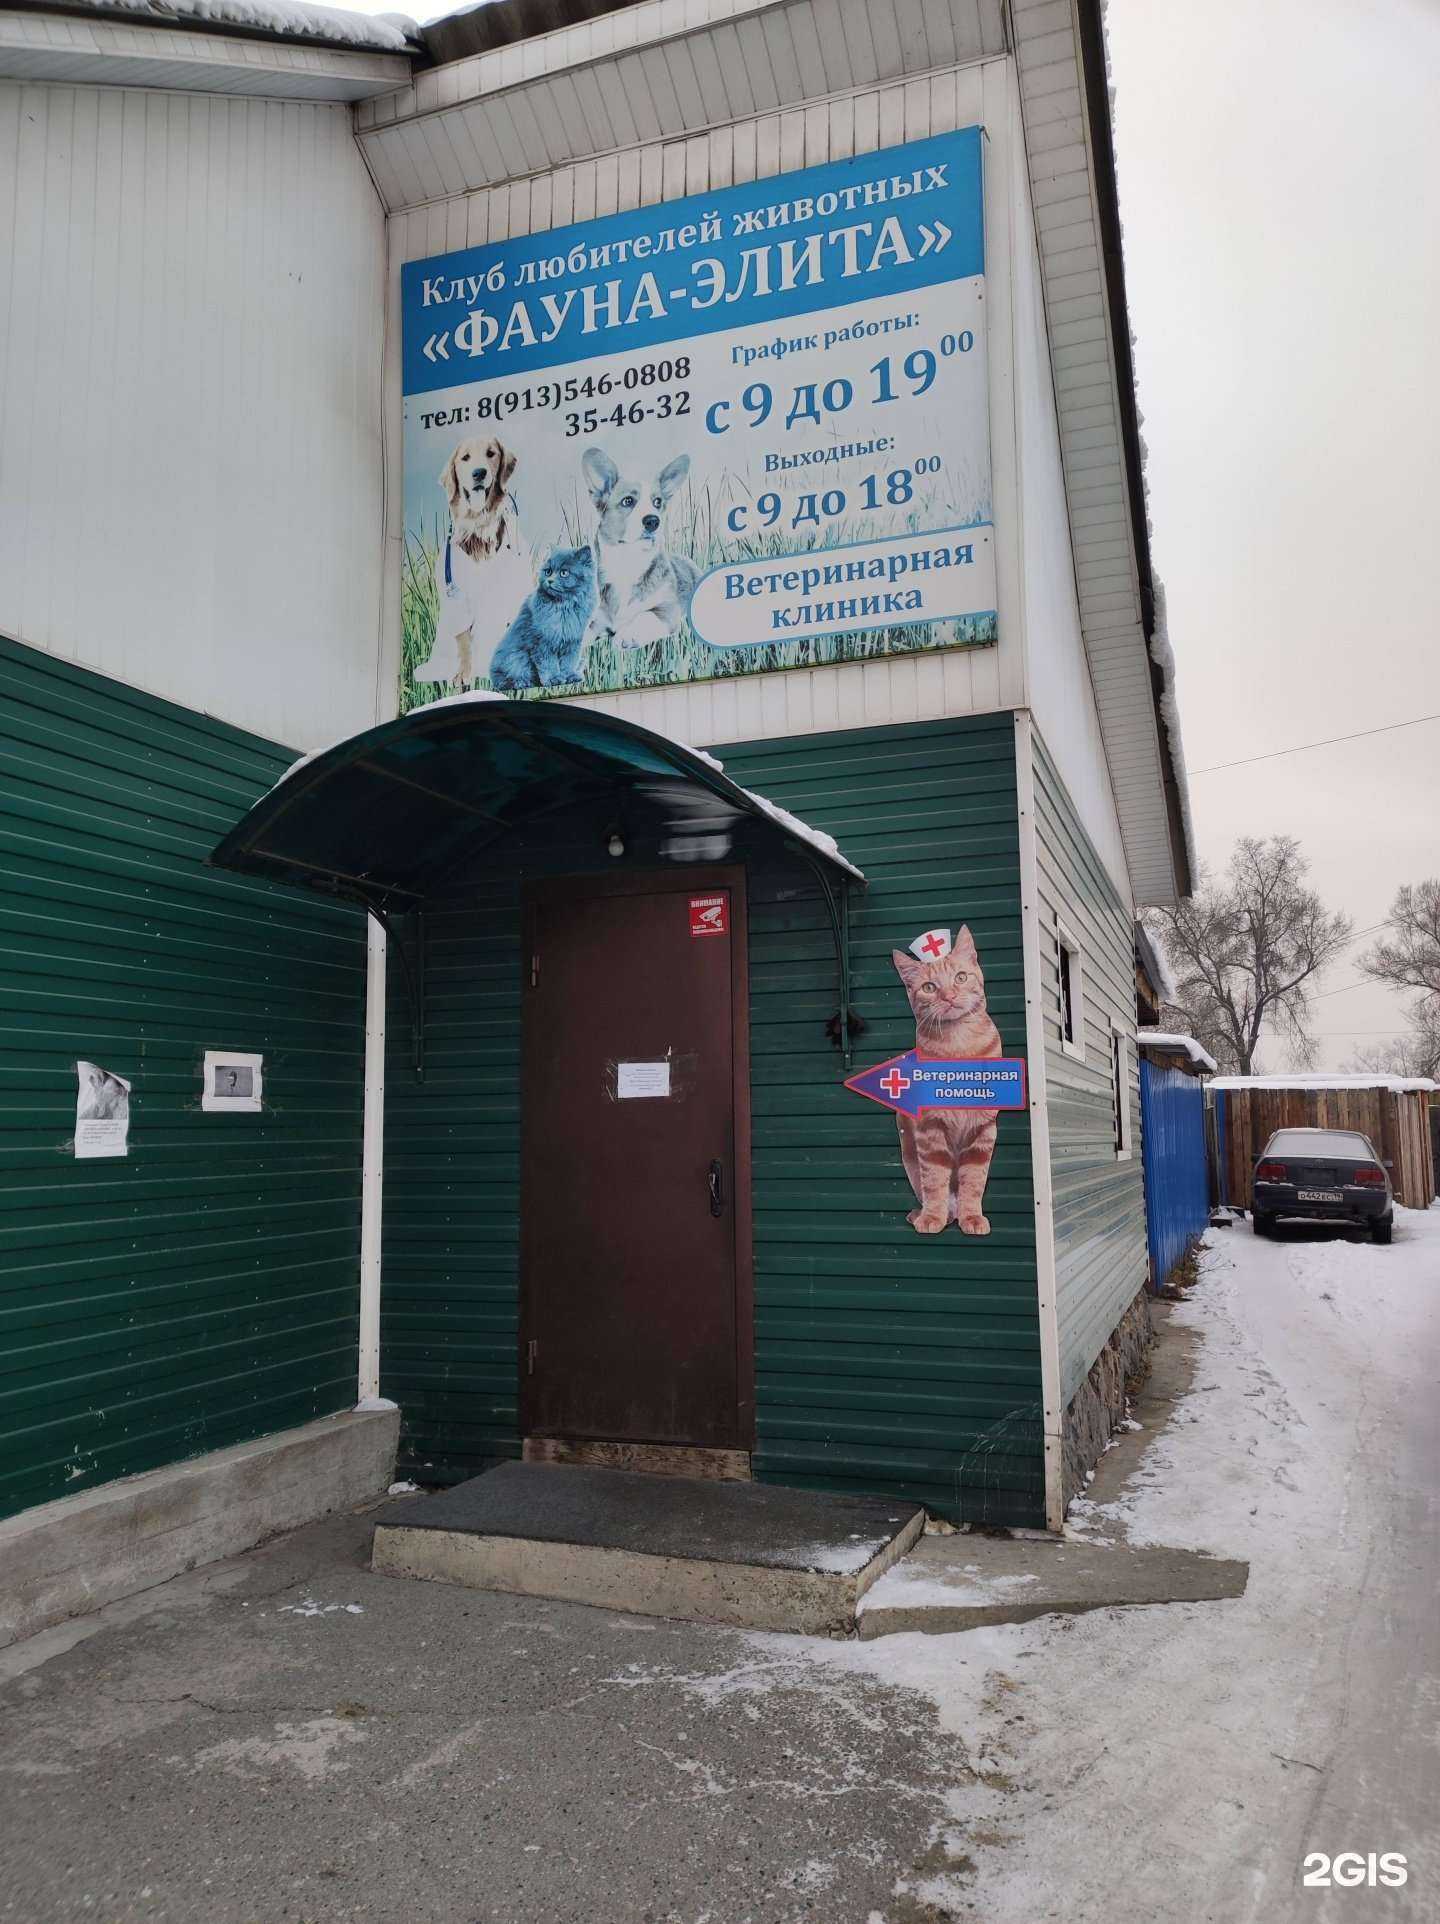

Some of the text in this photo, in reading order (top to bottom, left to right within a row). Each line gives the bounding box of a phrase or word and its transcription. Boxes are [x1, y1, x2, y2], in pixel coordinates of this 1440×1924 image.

[422, 164, 949, 307] Клуб любителей животных
[422, 216, 952, 362] «ФАУНА-ЭЛИТА»
[732, 312, 920, 366] График работы:
[420, 357, 691, 430] тел: 8(913)546-0808
[565, 391, 691, 437] 35-46-32
[705, 400, 731, 434] с
[742, 383, 773, 427] 9
[785, 379, 853, 430] до
[765, 436, 895, 472] Выходные:
[727, 505, 748, 532] с
[757, 492, 782, 527] 9
[792, 488, 846, 529] до
[725, 544, 974, 600] Ветеринарная
[771, 588, 923, 628] клиника
[912, 1069, 1018, 1084] Ветеринарная
[935, 1087, 995, 1099] помощь
